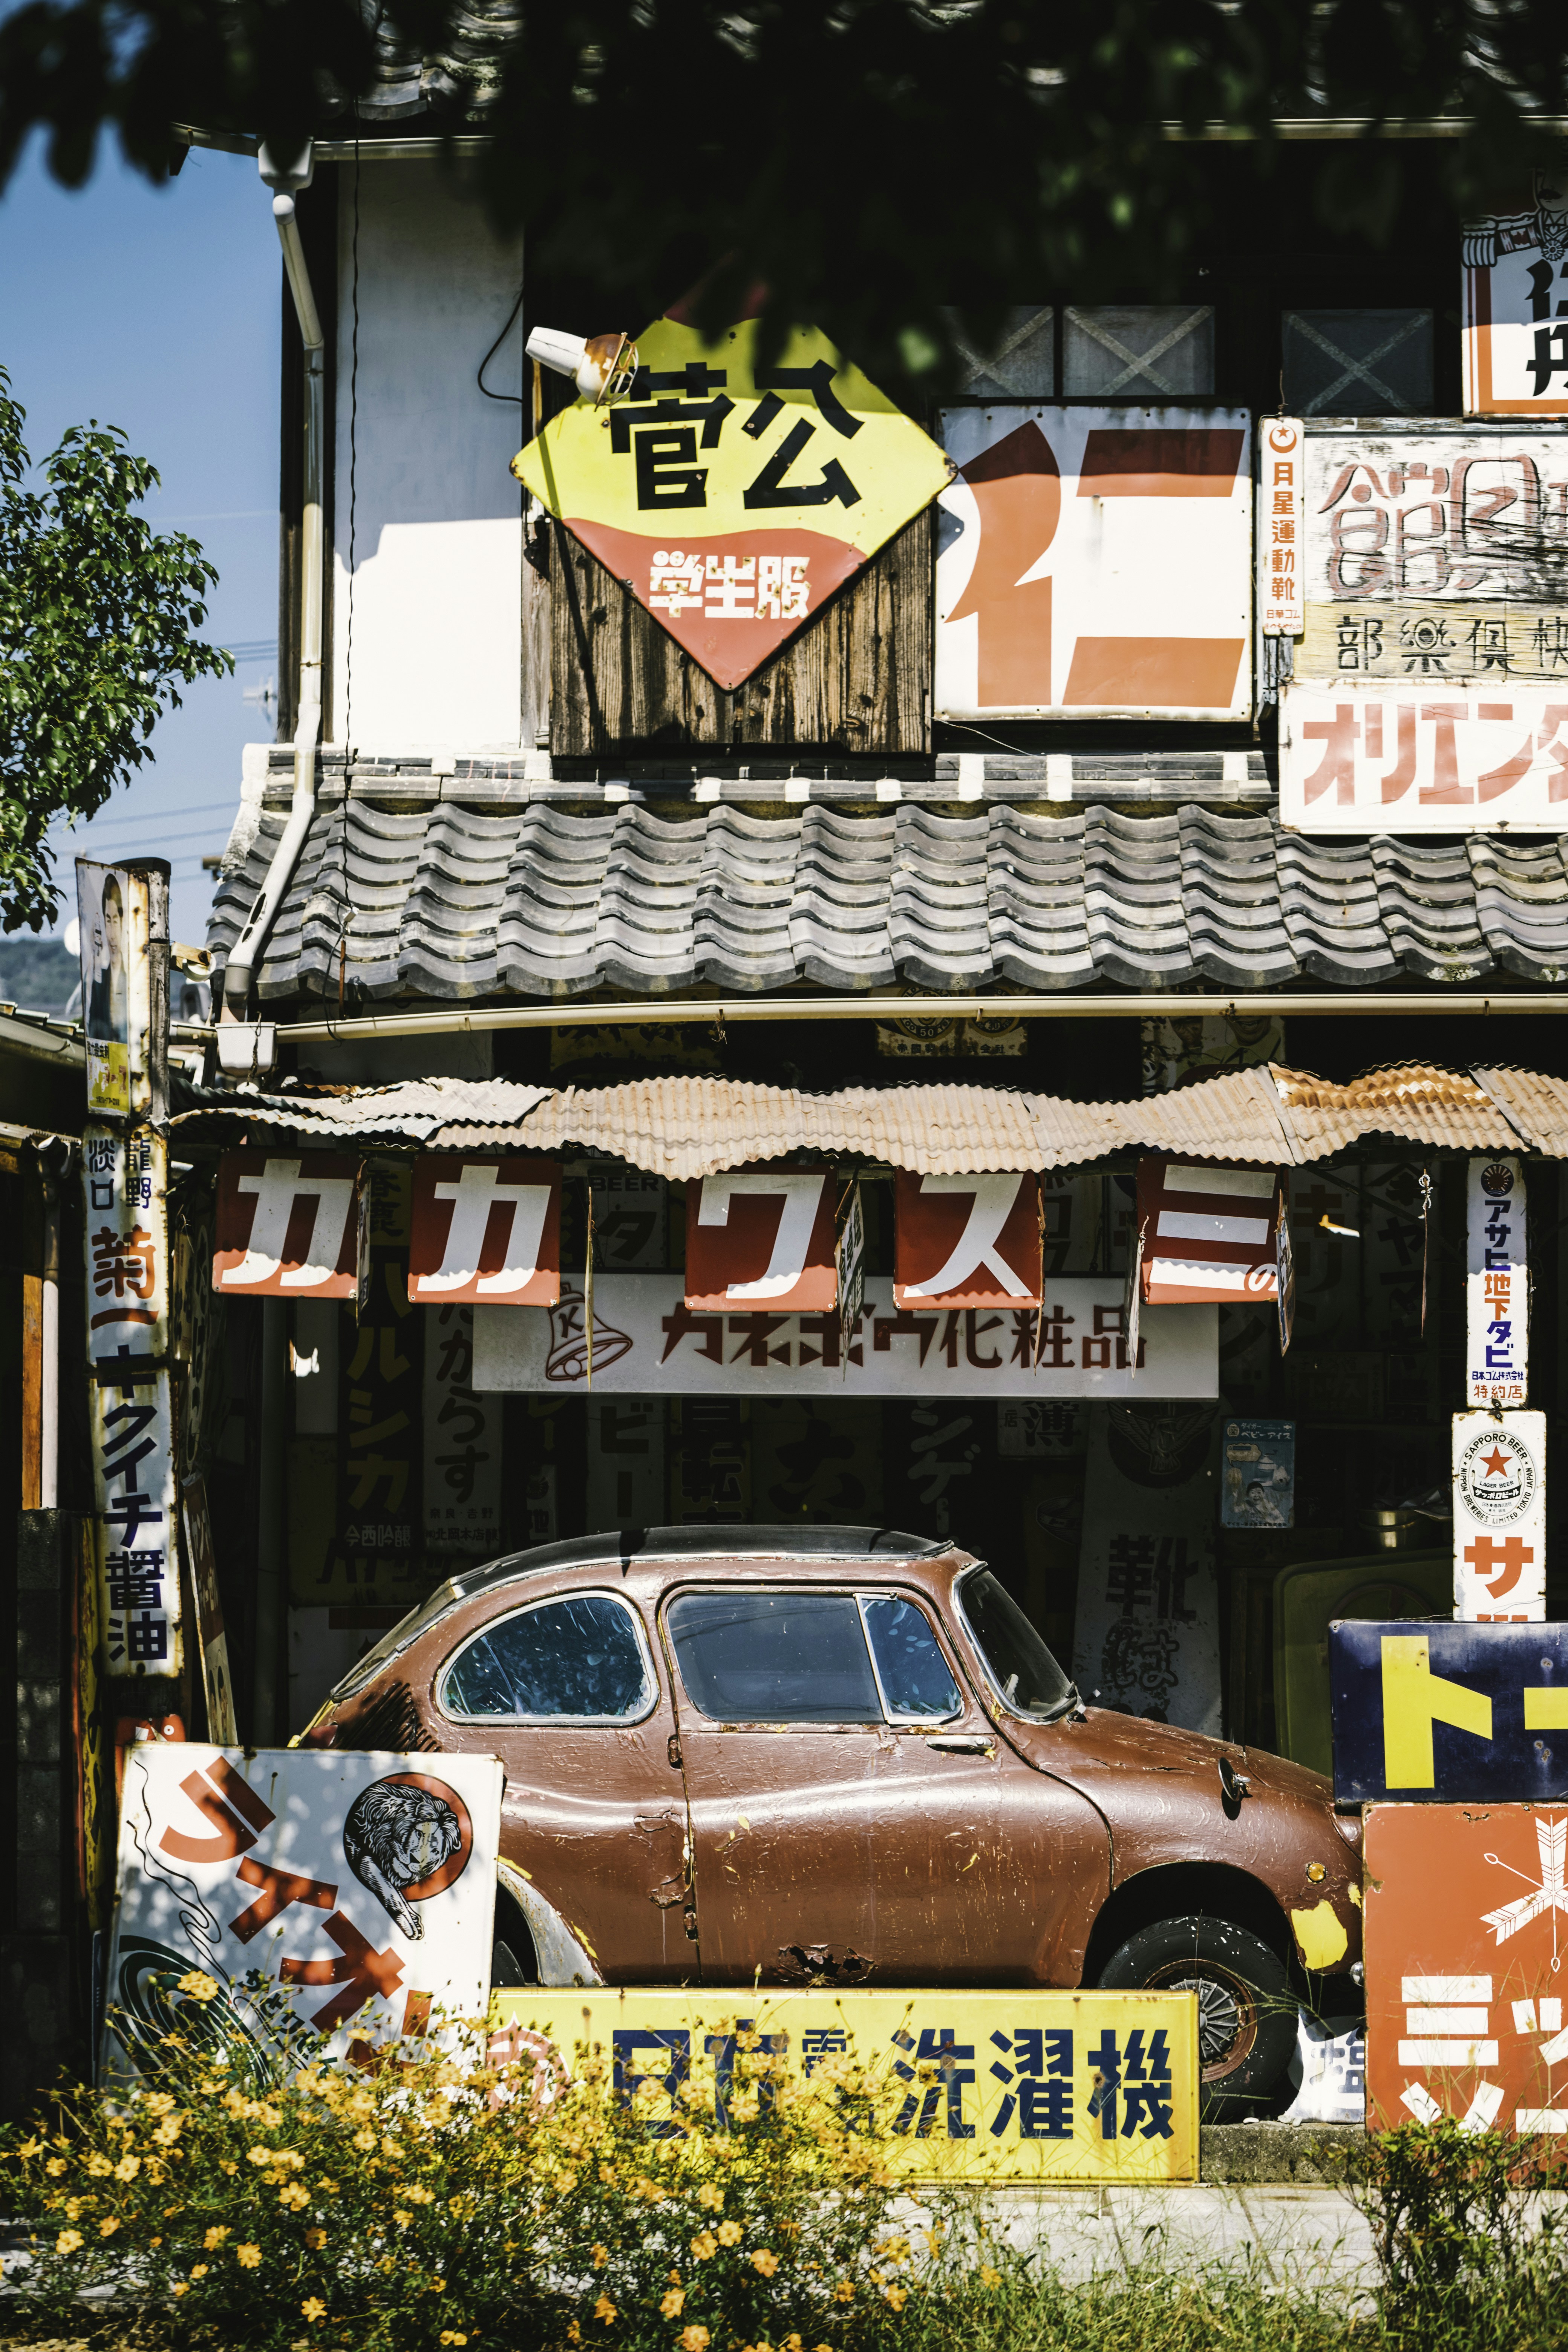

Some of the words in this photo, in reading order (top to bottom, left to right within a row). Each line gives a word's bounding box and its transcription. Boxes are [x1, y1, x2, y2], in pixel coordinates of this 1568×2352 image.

[609, 359, 865, 510] 菅公
[1272, 462, 1294, 600] 月星運動靴
[649, 550, 811, 619] 学生服
[90, 1224, 159, 1331] 菊一
[1484, 1200, 1513, 1368] アサヒ地下タビ
[662, 1302, 1146, 1369] カネボウ化粧品
[1472, 1371, 1524, 1380] 日本ゴム株式会社
[1474, 1384, 1522, 1398] 特約店
[1464, 1433, 1506, 1460] SAPPORO
[1507, 1438, 1527, 1459] BEER
[1464, 1494, 1488, 1523] BREWERIES
[1492, 1512, 1518, 1524] LIMITED
[1517, 1491, 1531, 1511] TOKYO
[1475, 1489, 1519, 1499] サッポロビール
[1464, 1536, 1534, 1621] サ
